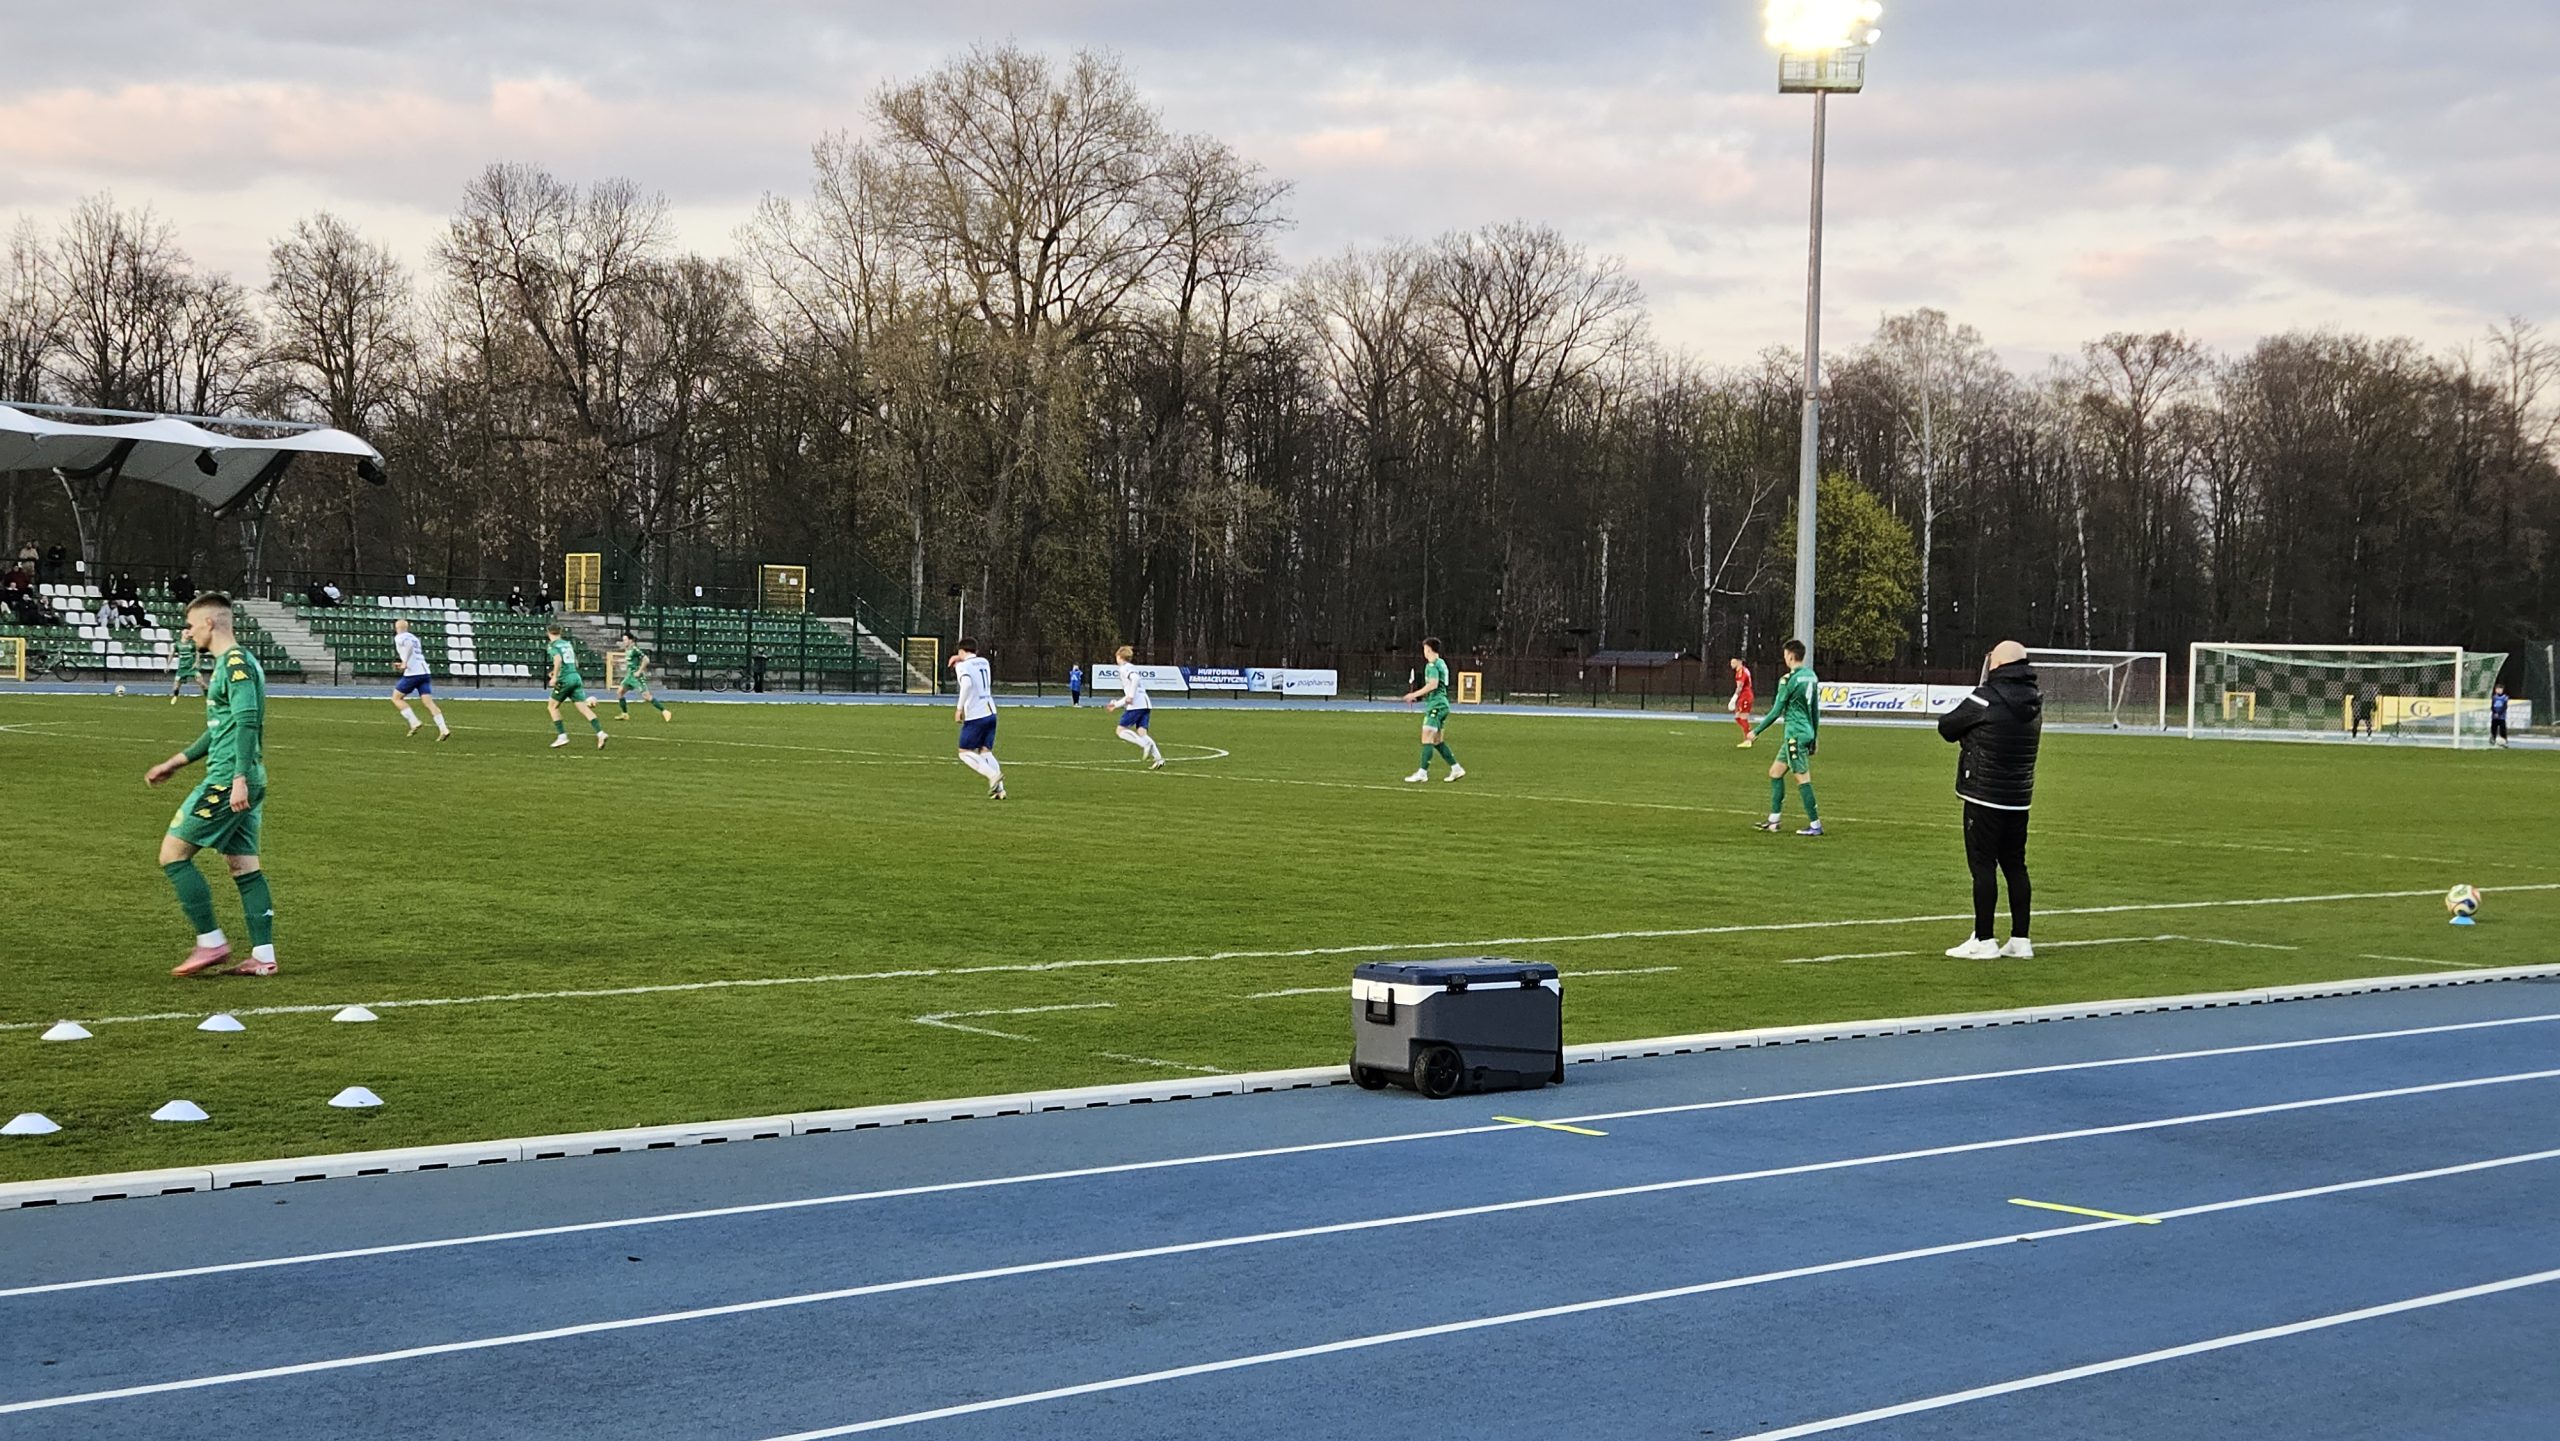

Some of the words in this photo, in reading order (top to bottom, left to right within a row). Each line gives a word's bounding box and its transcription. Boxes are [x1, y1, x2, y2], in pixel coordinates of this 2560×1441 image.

[1098, 670, 1156, 678] ASCIOS
[1820, 686, 1850, 704] KS
[1846, 697, 1905, 710] Sieradz
